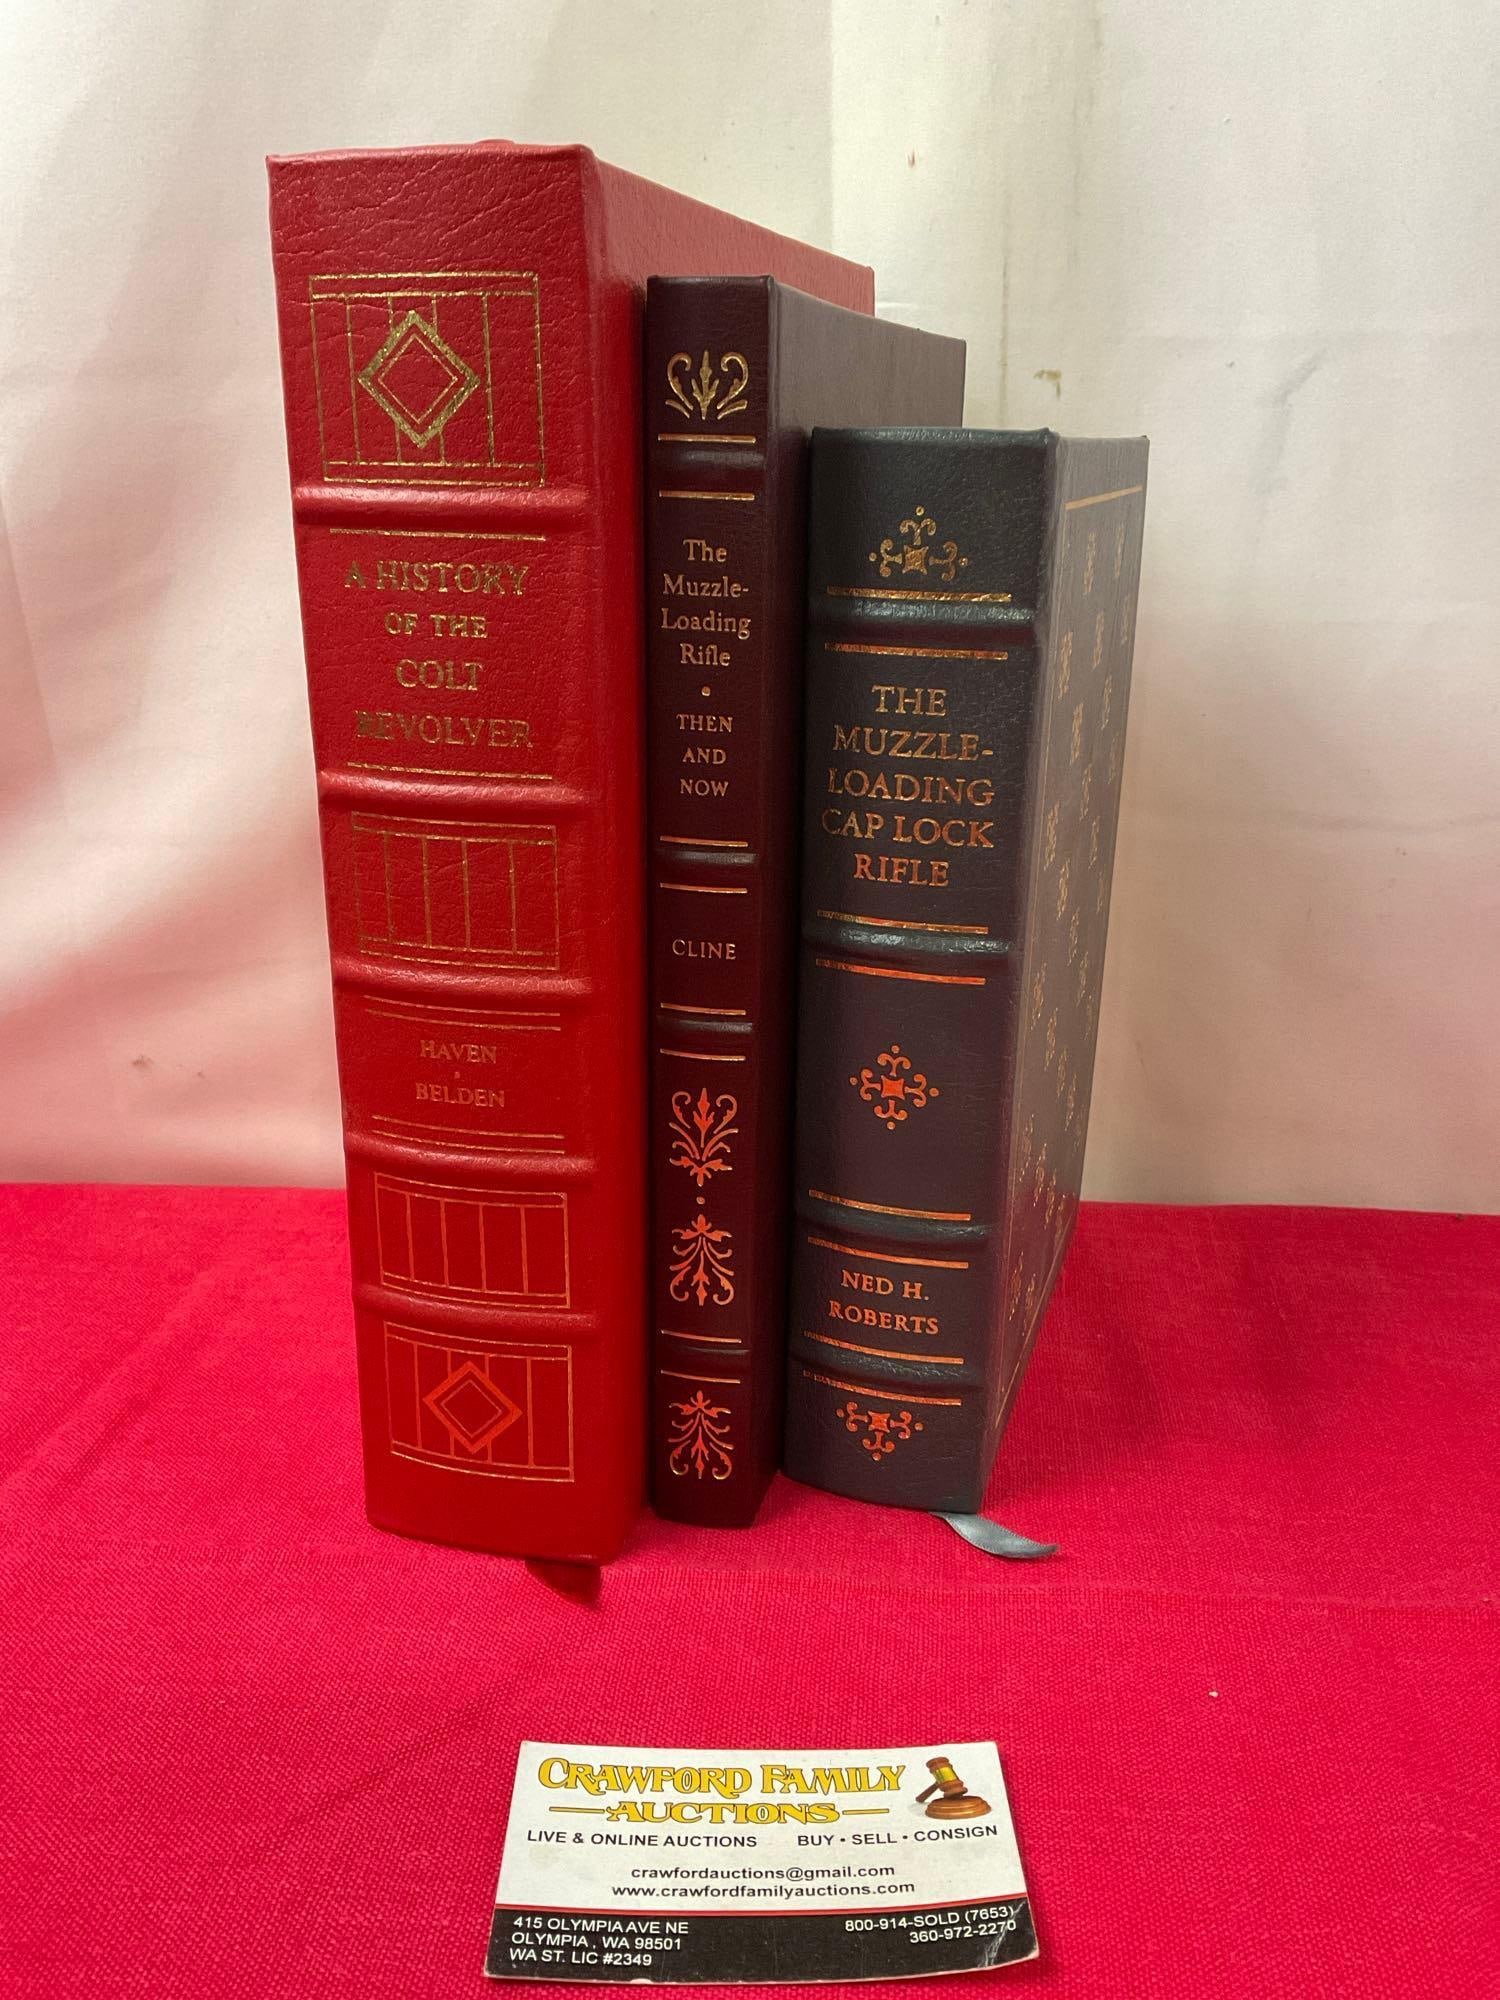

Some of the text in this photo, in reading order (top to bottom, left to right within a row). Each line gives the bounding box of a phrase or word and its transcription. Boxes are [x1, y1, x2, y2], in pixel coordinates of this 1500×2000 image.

[683, 539, 727, 562] The
[345, 560, 529, 595] A HISTORY
[663, 573, 749, 598] Muzzle-
[384, 612, 488, 638] OF THE
[661, 607, 751, 640] Loading
[680, 643, 731, 666] Rifle
[396, 659, 483, 691] COLT
[871, 684, 947, 716] THE
[355, 710, 533, 748] REVOLVER
[676, 713, 733, 733] THEN
[833, 725, 994, 761] MUZZLE-
[682, 747, 726, 765] AND
[680, 778, 729, 797] NOW
[828, 767, 995, 807] LOADING
[821, 808, 994, 848] CAP LOCK
[854, 853, 950, 887] RIFLE
[671, 939, 737, 960] CLINE
[419, 1039, 497, 1064] HAVEN
[415, 1082, 505, 1108] BELDEN
[840, 1269, 930, 1301] NED H.
[828, 1300, 940, 1335] ROBERTS
[538, 1757, 906, 1799] CRAWFORD FAMILY
[606, 1801, 840, 1825] AUCTIONS
[527, 1830, 757, 1847] LIVE & ONLINE AUCTIONS
[797, 1825, 998, 1847] BUY SELL CONSIGN
[630, 1866, 896, 1882] crawfordauctions@gmail.com
[611, 1882, 916, 1900] www.crawfordfamilyauctions.com
[513, 1917, 543, 1930] 415
[665, 1922, 689, 1934] NE
[844, 1905, 1015, 1932] 800-914-SOLD (7653)
[602, 1937, 631, 1949] WA
[634, 1938, 682, 1951] 98501
[909, 1919, 1018, 1944] 360-972-2270
[509, 1948, 653, 1966] WA ST. LIC #2349
